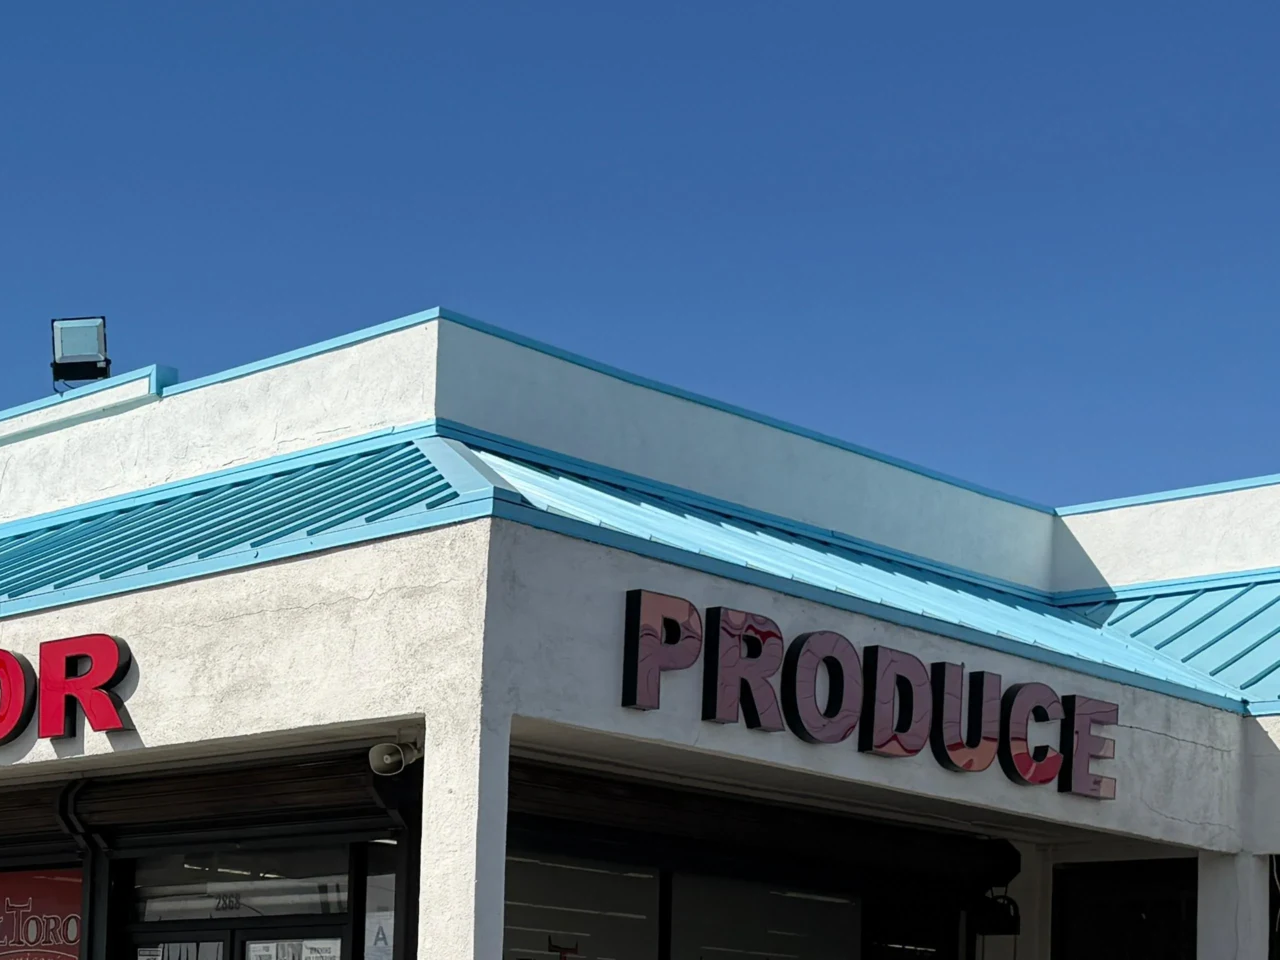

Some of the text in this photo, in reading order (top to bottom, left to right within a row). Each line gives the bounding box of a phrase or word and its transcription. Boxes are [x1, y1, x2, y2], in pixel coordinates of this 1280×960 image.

[621, 588, 1120, 801] PRODUCE
[215, 893, 241, 911] 2868
[5, 897, 81, 946] TORO
[373, 925, 388, 946] A
